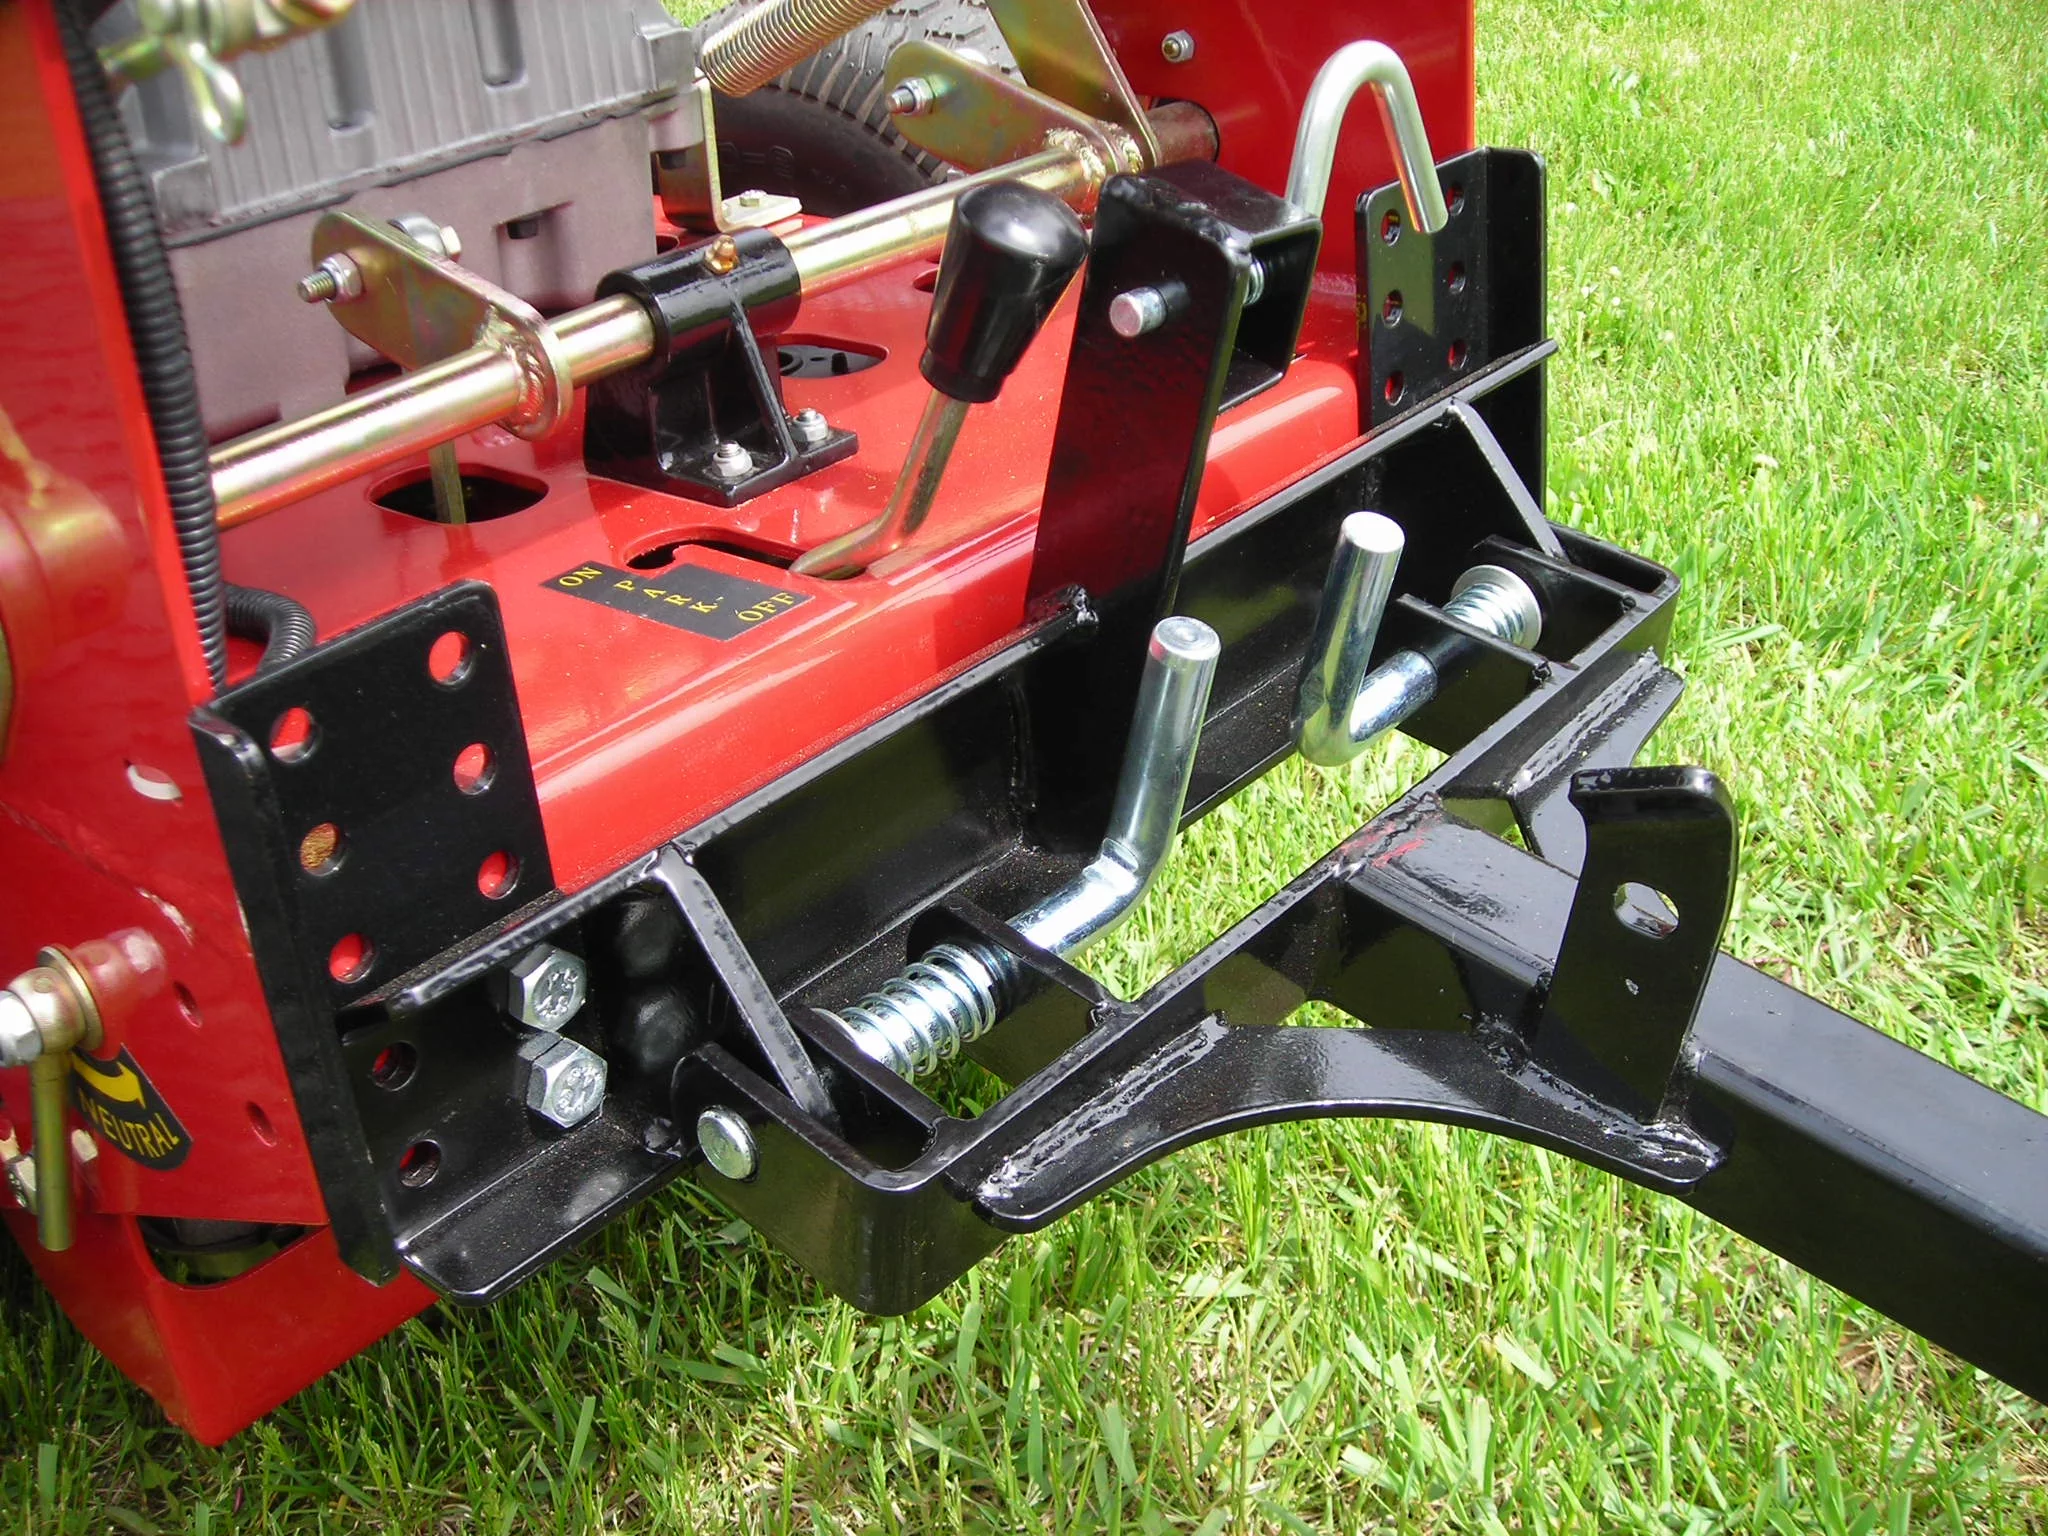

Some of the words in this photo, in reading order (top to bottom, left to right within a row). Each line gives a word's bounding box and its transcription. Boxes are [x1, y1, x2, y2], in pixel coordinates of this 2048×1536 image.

[559, 566, 603, 588] ON
[736, 592, 796, 623] OFF
[78, 1087, 180, 1158] NEUTRAL
